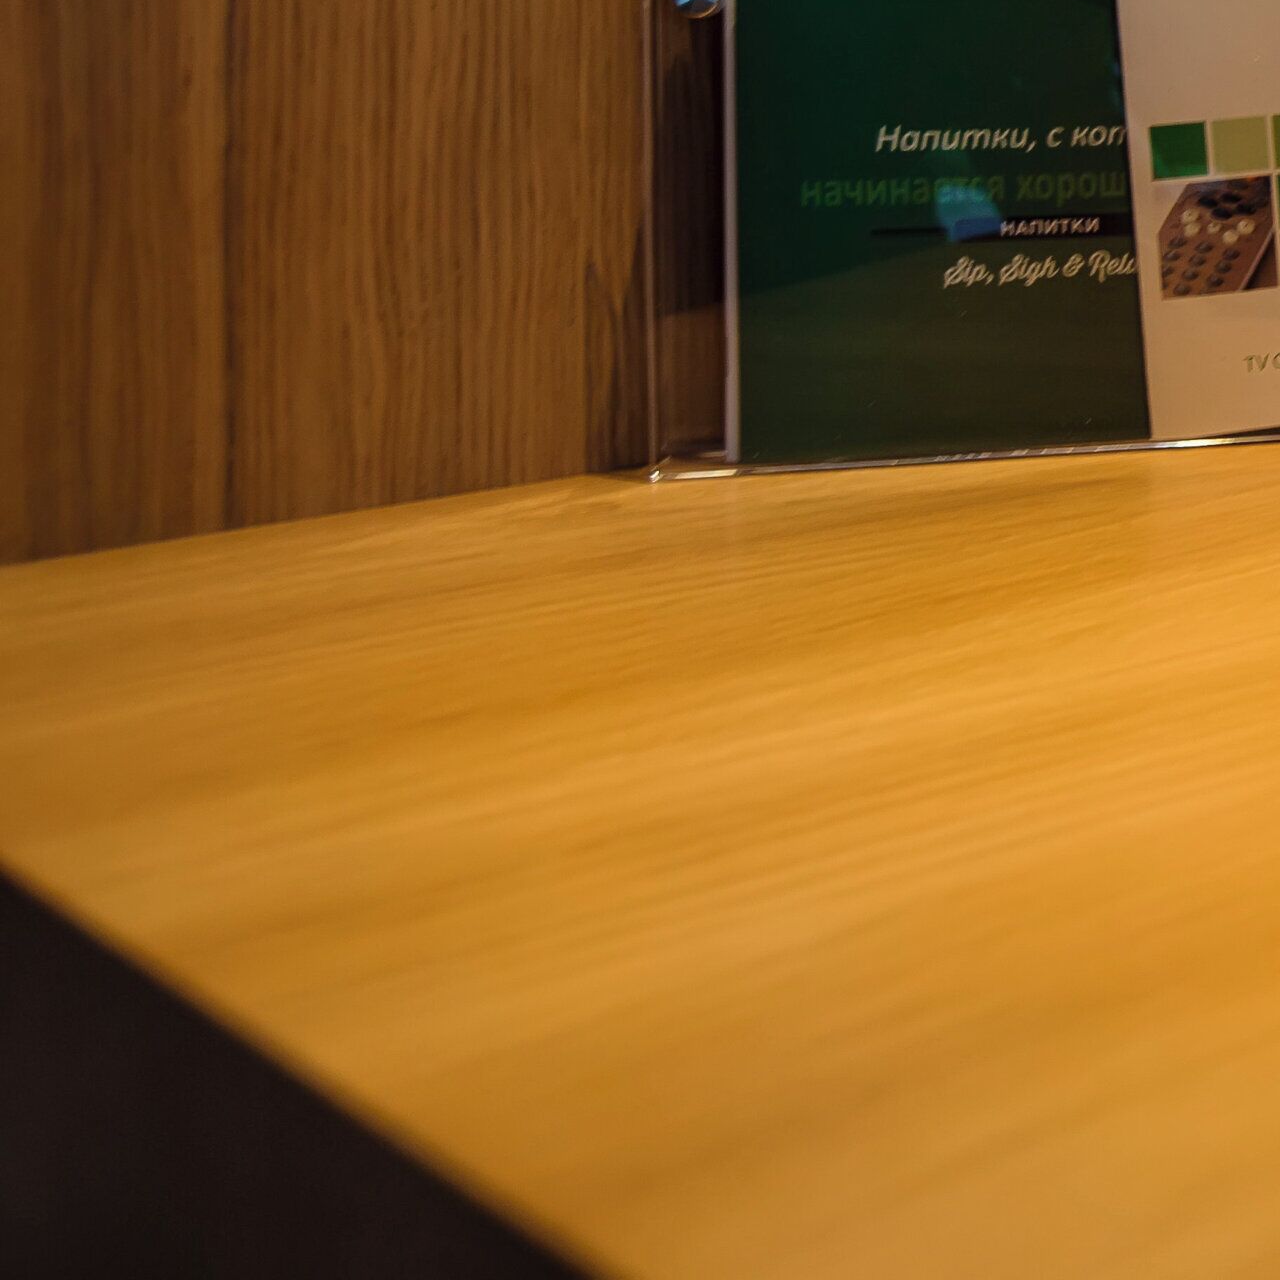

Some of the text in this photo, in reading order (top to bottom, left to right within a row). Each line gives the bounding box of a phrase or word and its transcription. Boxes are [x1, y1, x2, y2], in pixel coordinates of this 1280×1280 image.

[875, 124, 1037, 153] Напитки,
[1000, 216, 1102, 237] НАПИТКИ
[943, 255, 995, 289] Sip,
[999, 253, 1061, 287] Sigh
[1063, 252, 1086, 278] &
[1243, 353, 1270, 372] TV
